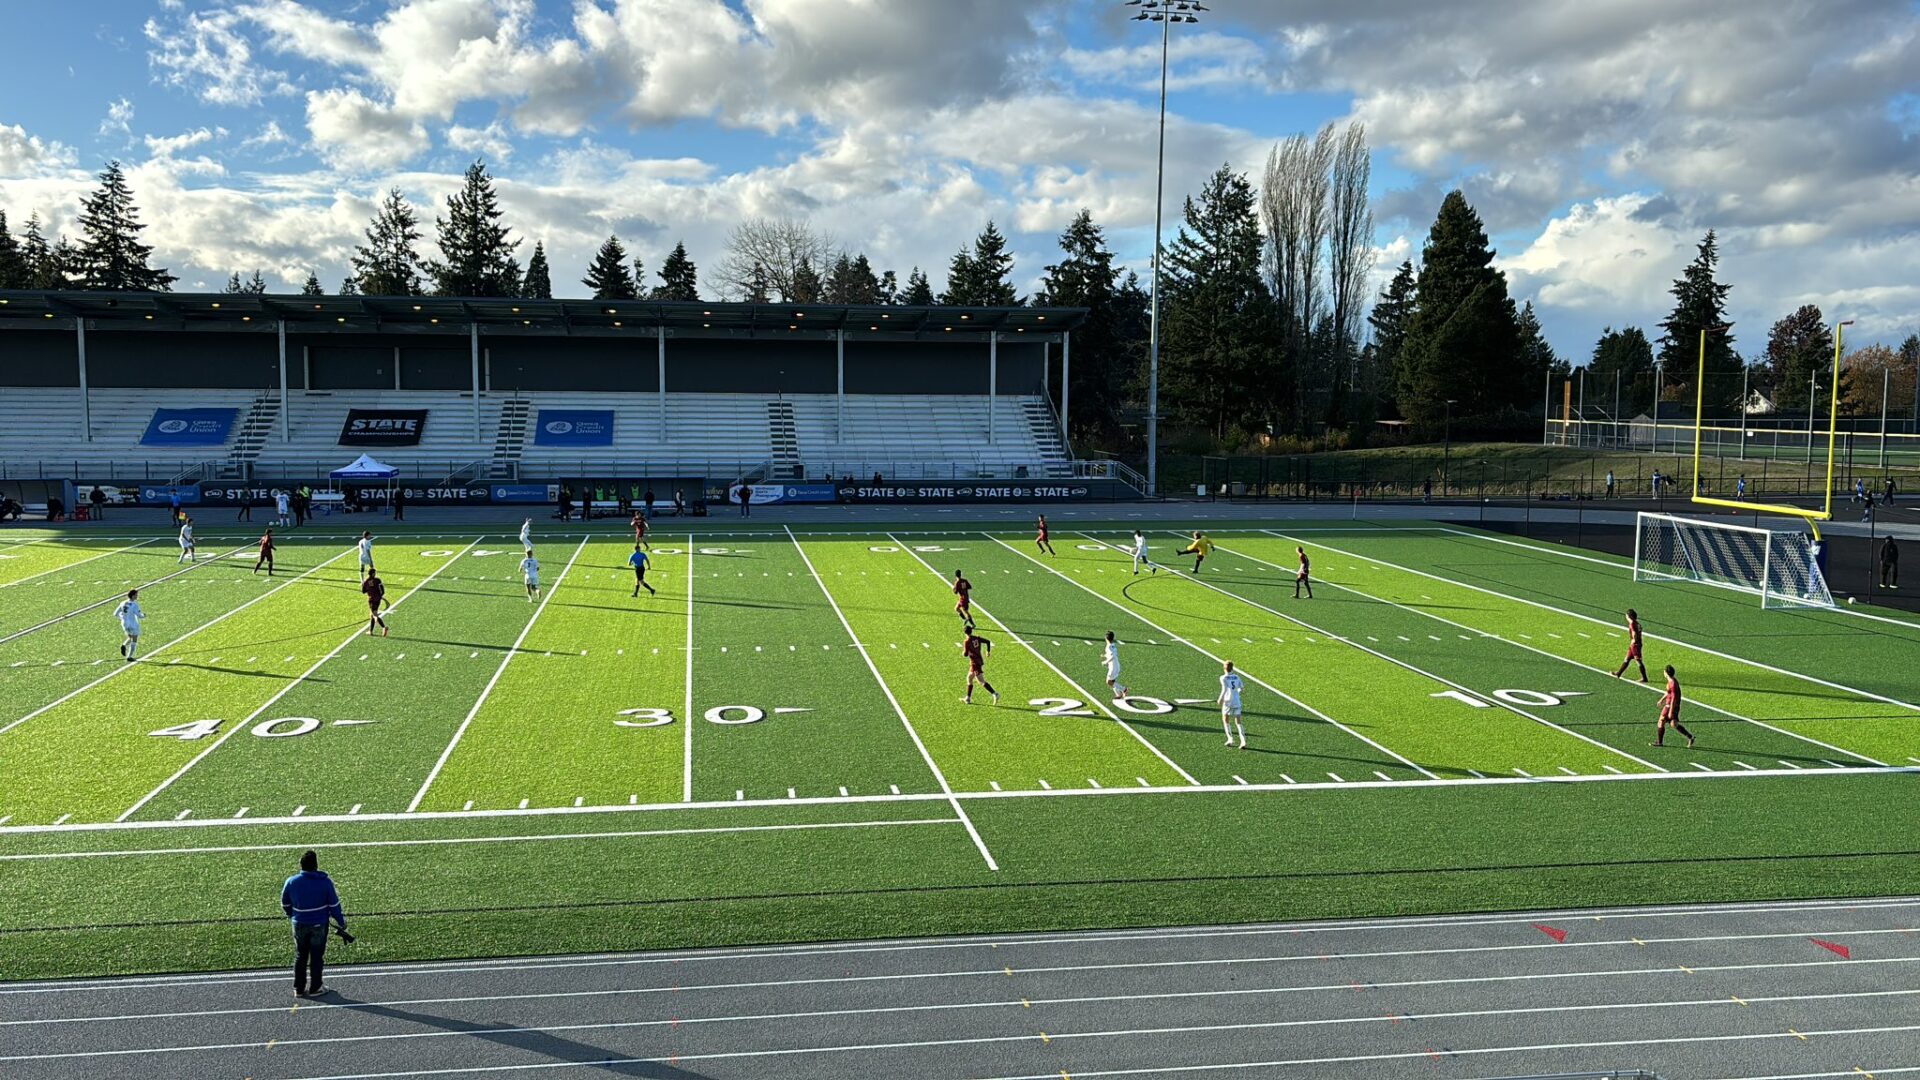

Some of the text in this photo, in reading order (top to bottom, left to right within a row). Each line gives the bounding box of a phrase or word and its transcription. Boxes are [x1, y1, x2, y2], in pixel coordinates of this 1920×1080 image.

[351, 418, 418, 431] STATE
[426, 488, 467, 499] STATE
[858, 487, 894, 497] STATE
[918, 487, 954, 497] STATE
[975, 487, 1011, 497] STATE
[1034, 487, 1070, 497] STATE
